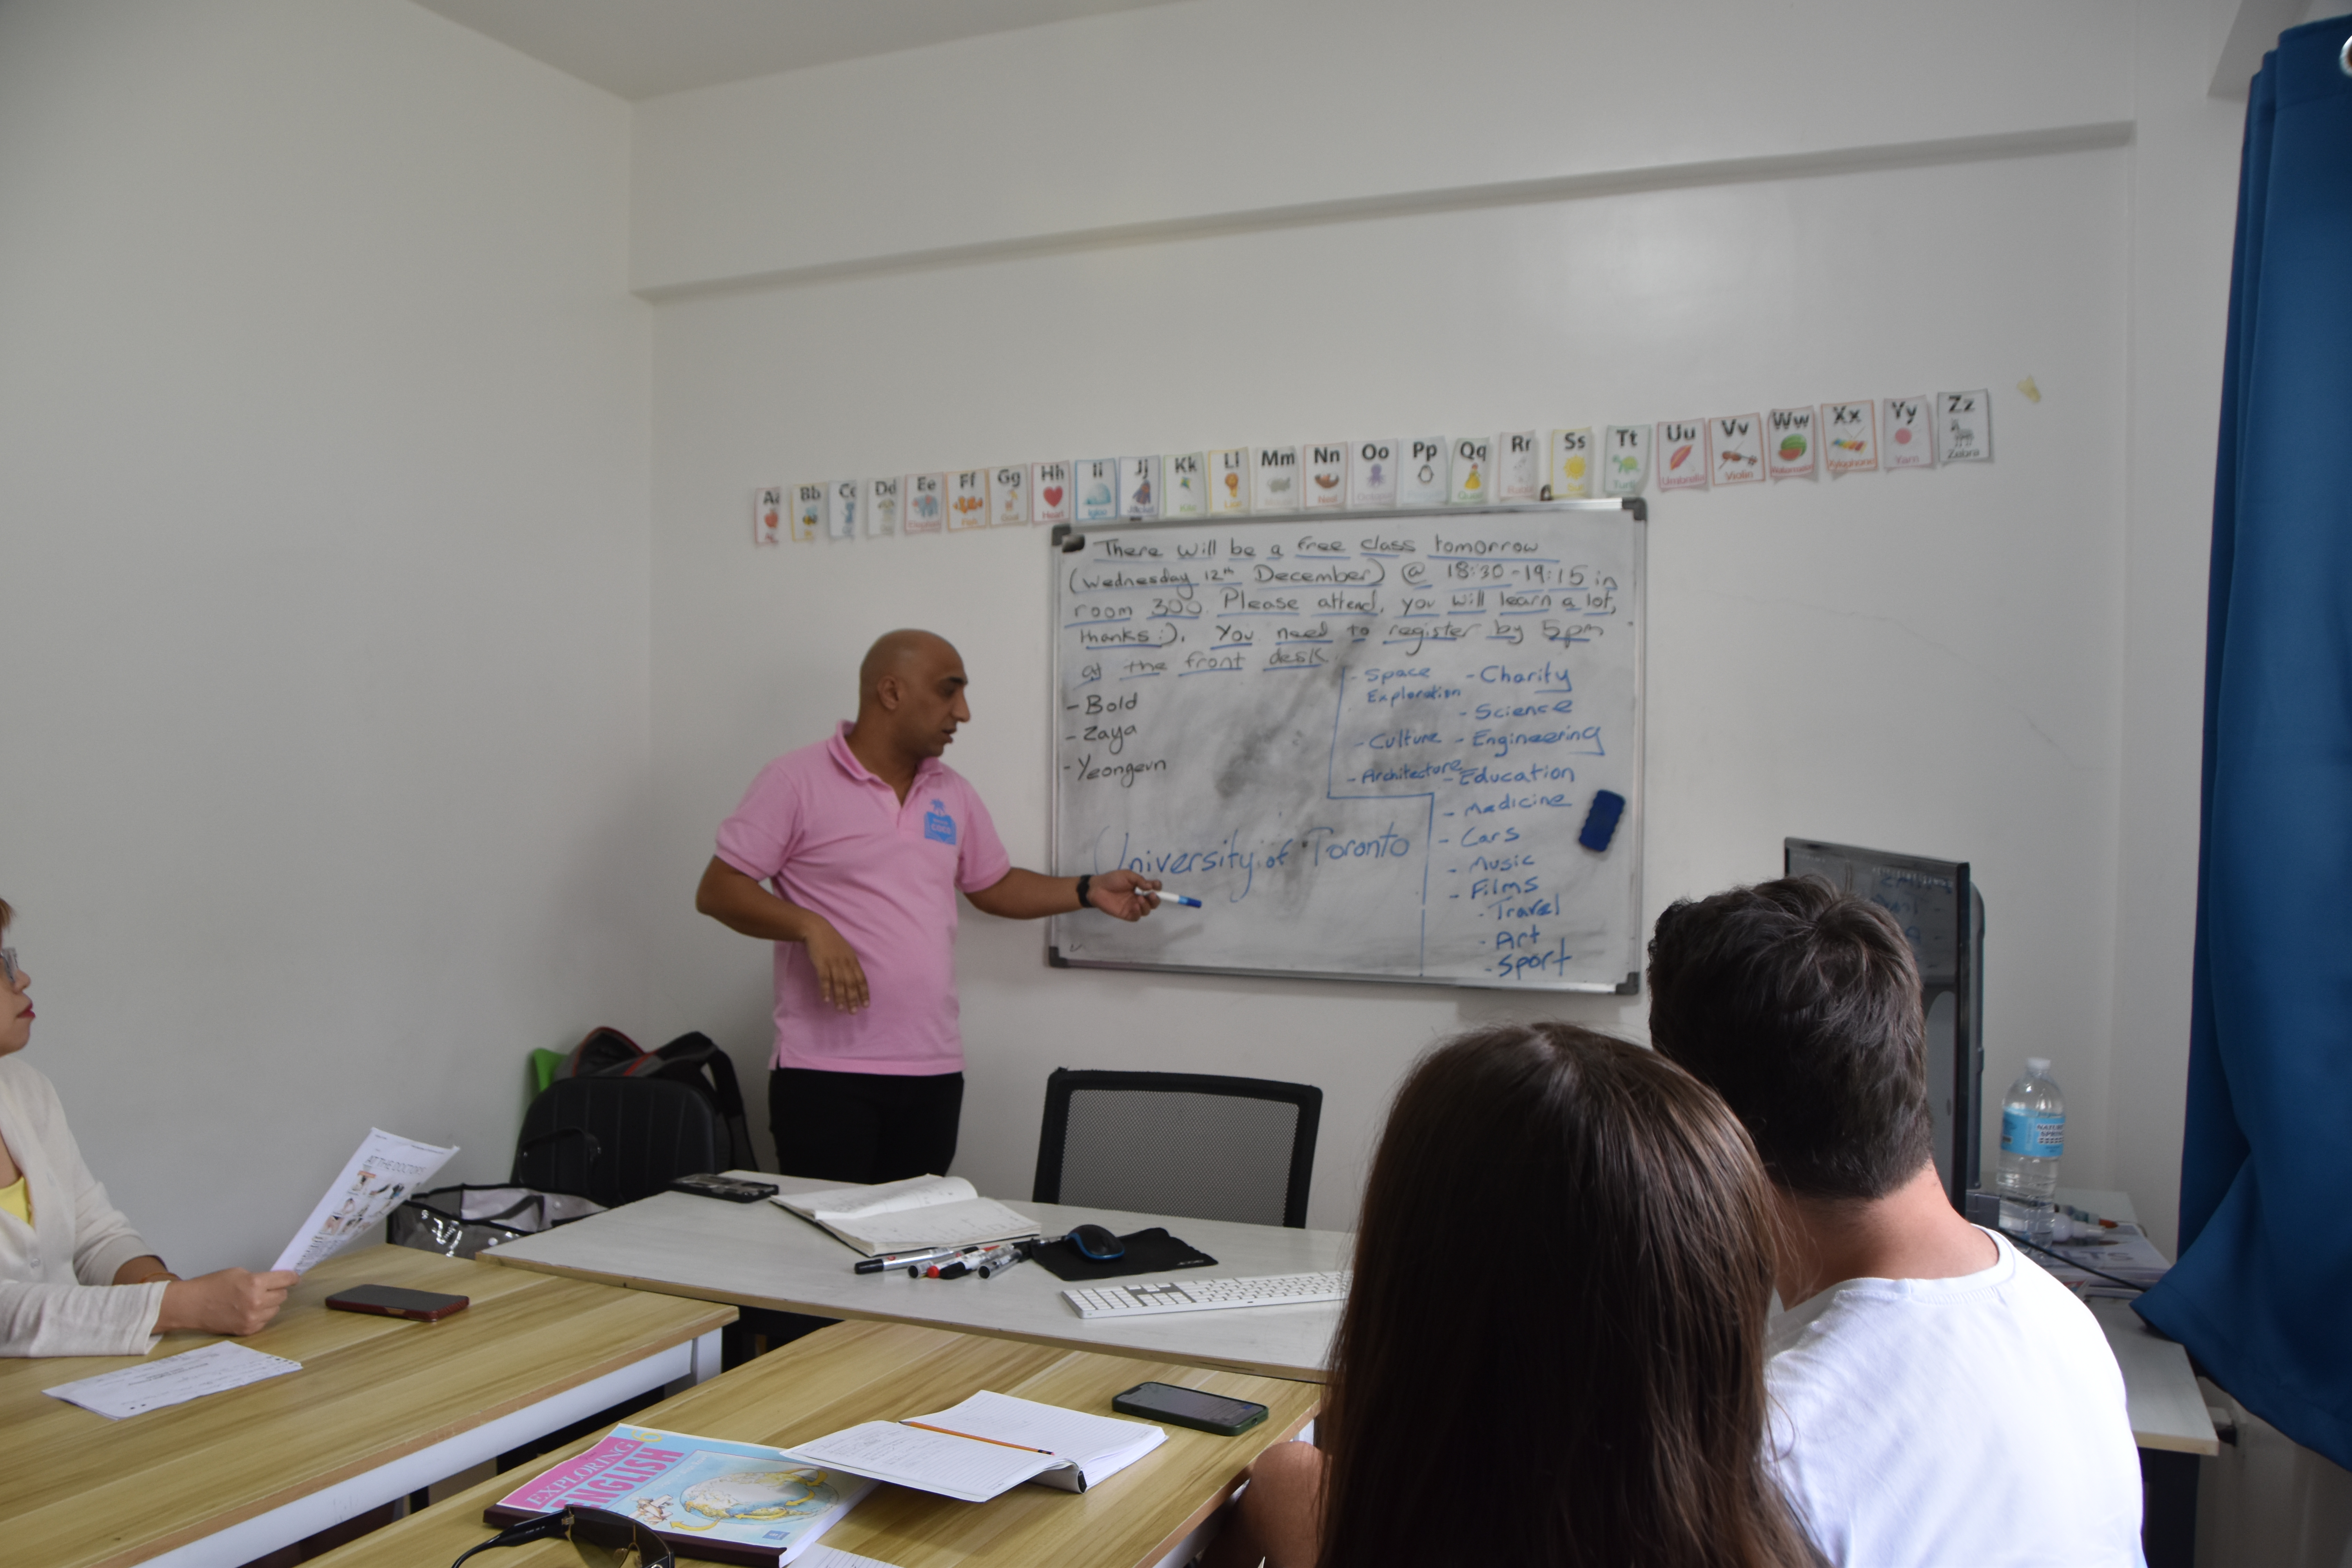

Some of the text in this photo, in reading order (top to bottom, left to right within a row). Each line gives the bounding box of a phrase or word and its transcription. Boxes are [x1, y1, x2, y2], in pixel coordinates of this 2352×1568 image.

[1892, 401, 1918, 425] Yy
[1949, 394, 1975, 413] Zz
[1773, 411, 1810, 430] Ww
[1833, 406, 1862, 424] Xx
[1616, 429, 1638, 446] Tt
[1667, 424, 1697, 442] Uu
[1721, 419, 1749, 437] Vv
[1564, 432, 1586, 450] Ss
[1262, 450, 1295, 466] Mm
[1314, 447, 1340, 463] Nn
[1362, 443, 1389, 460] Oo
[1413, 441, 1438, 461] Pp
[1460, 441, 1487, 461] Qq
[1895, 455, 1920, 465] Yarn
[1947, 448, 1980, 459] Zebra
[1135, 459, 1148, 479] Jj
[1175, 456, 1197, 473] Kk
[1828, 457, 1876, 469] Xylophone
[960, 472, 975, 489] Ff
[998, 469, 1020, 487] Gg
[1041, 465, 1064, 481] Hh
[1662, 473, 1705, 486] Umbrella
[1726, 470, 1754, 481] Violin
[800, 486, 821, 501] Bb
[875, 478, 897, 496] Dd
[917, 476, 936, 492] Ee
[1093, 533, 1539, 557] There will be a free class tomorrow
[1401, 561, 1426, 586] @
[1595, 571, 1618, 588] in
[1074, 604, 1133, 619] room
[1223, 587, 1300, 610] Please
[1401, 597, 1436, 616] you
[1452, 589, 1485, 606] will
[1500, 590, 1552, 606] learn
[1562, 597, 1576, 608] a
[1277, 621, 1328, 639] need
[1347, 624, 1370, 636] to
[1389, 622, 1482, 656] register
[1494, 619, 1524, 644] by
[1123, 660, 1168, 673] the
[1185, 651, 1246, 670] front
[1365, 667, 1430, 685] Space
[1480, 661, 1573, 691] Charity
[1085, 693, 1138, 715] Bold
[1367, 685, 1461, 706] Exploration
[1475, 699, 1573, 720] Science
[1083, 724, 1136, 755] Zaya
[1368, 729, 1442, 749] Culture
[1472, 726, 1605, 757] Engineering
[1459, 763, 1575, 786] Education
[1464, 793, 1573, 817] Medicine
[1461, 826, 1521, 847] Cars
[1094, 822, 1410, 902] University of Toronto
[1468, 855, 1535, 874] Music
[1471, 876, 1539, 900] Films
[1488, 893, 1560, 920] Travel
[1496, 924, 1540, 950] Art
[631, 1429, 663, 1443] 6
[526, 1441, 633, 1506] EXPLORING
